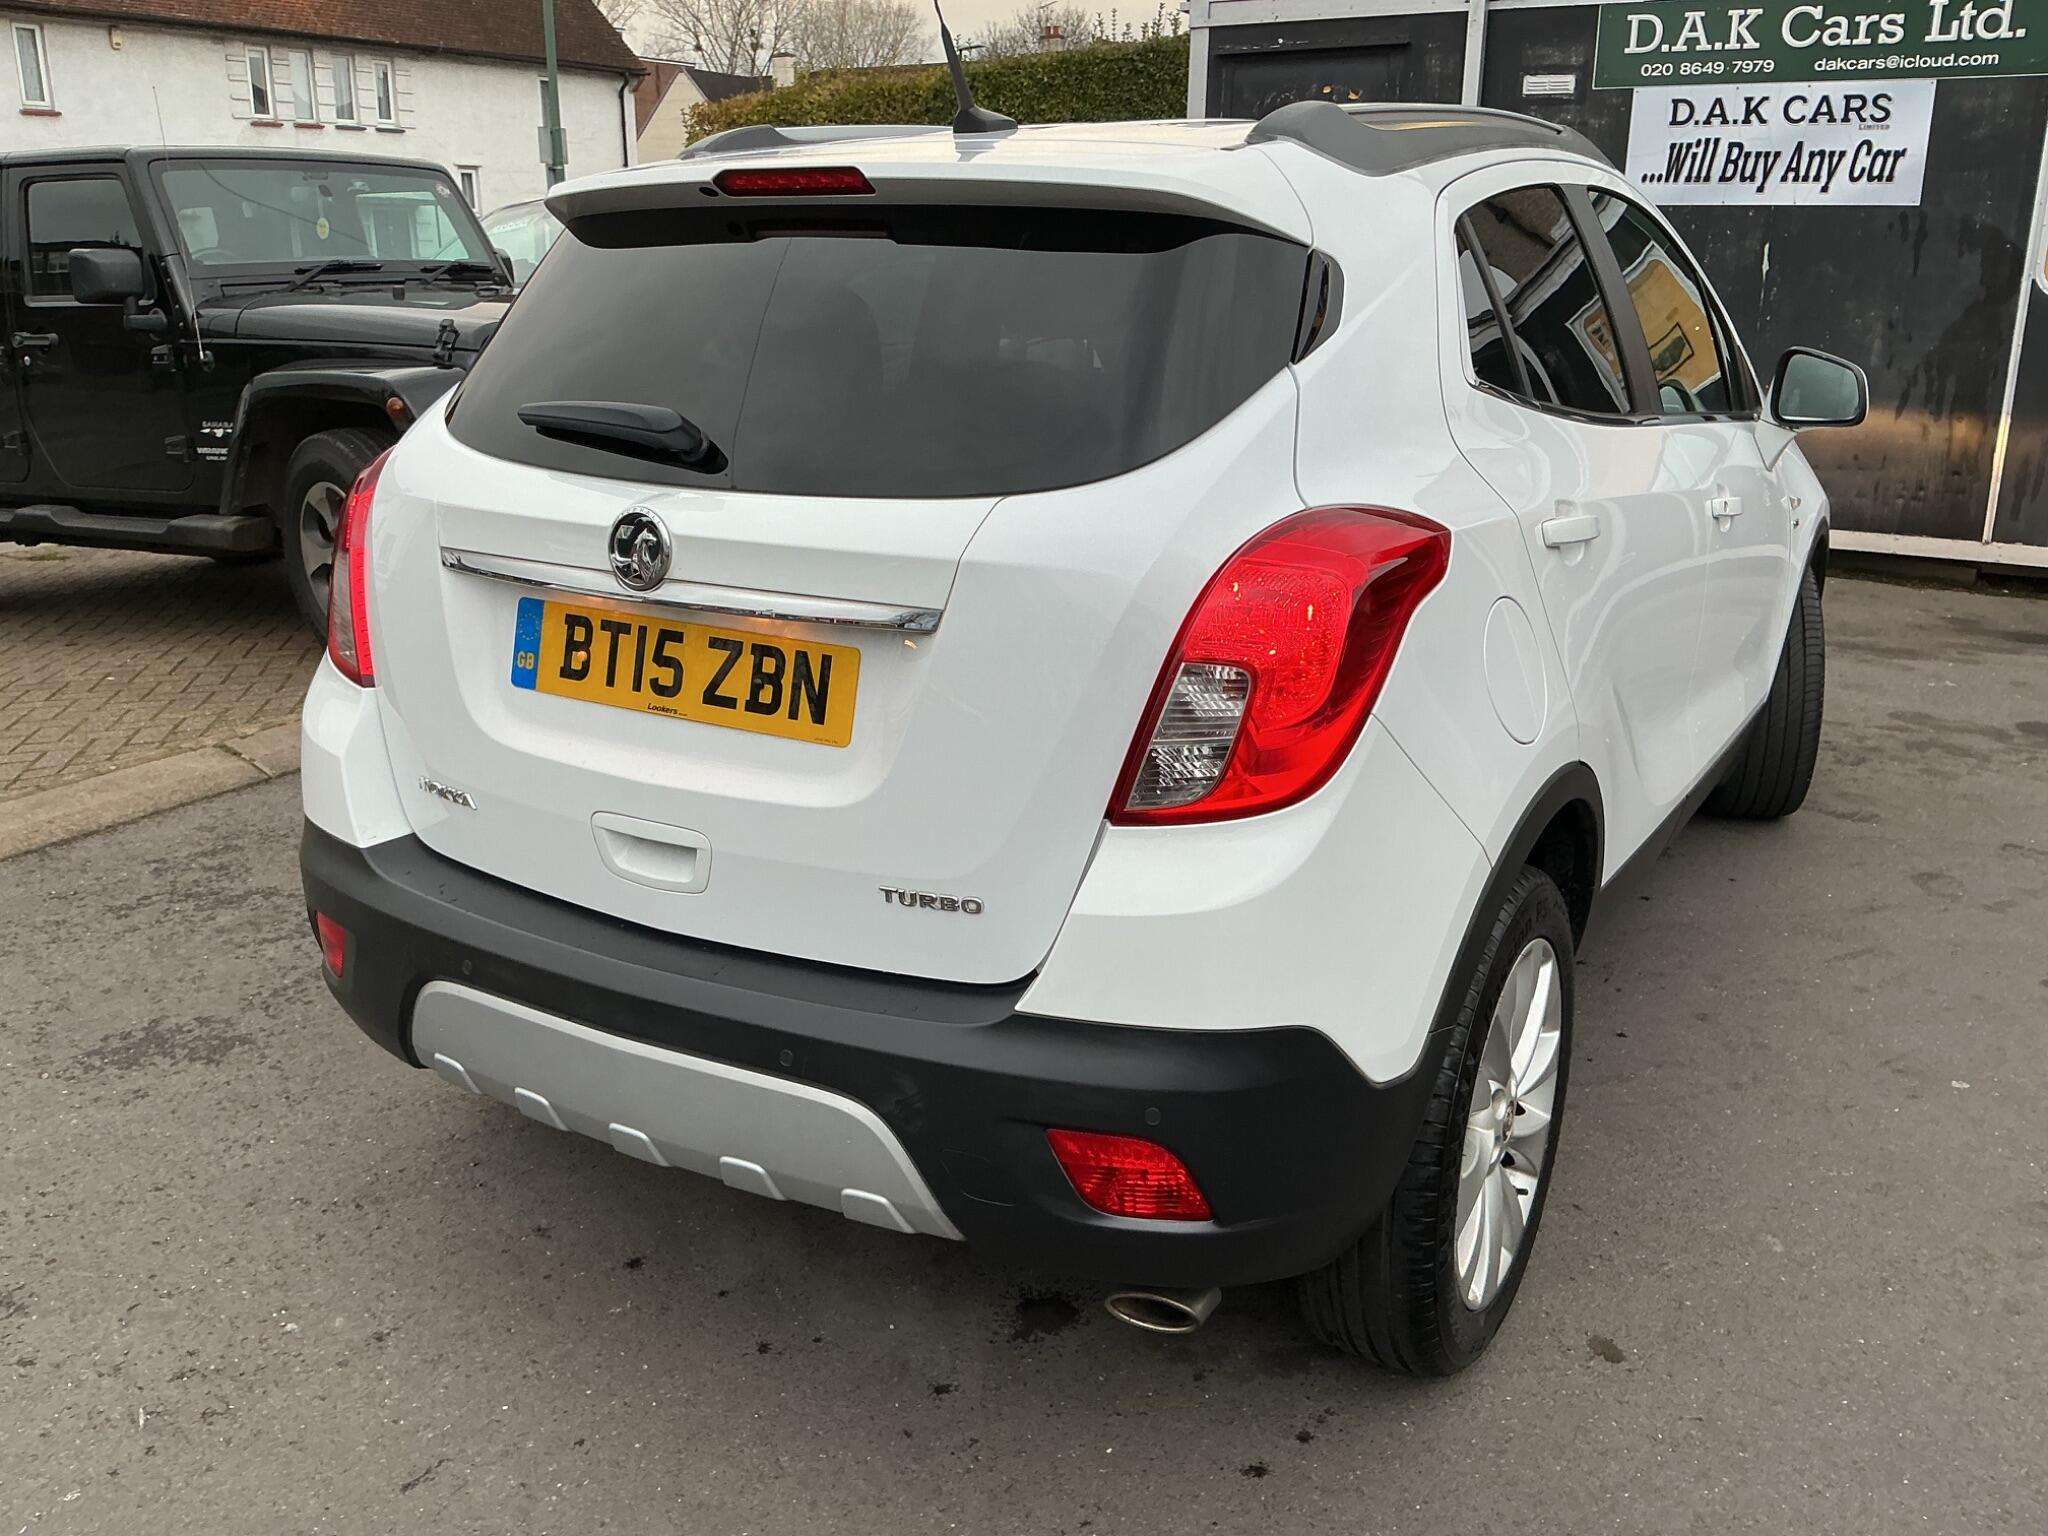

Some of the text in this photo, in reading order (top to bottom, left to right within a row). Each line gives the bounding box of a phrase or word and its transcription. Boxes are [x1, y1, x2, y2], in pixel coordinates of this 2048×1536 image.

[1624, 0, 2027, 54] D.A.K Cars Ltd.
[1641, 59, 1775, 76] 020 8649 7979
[1814, 53, 2000, 72] dakcars@icloud.com
[1668, 93, 1892, 126] D.A.K CARS
[1718, 141, 1781, 193] Buy
[1780, 140, 1846, 193] Any
[1848, 139, 1907, 184] Car
[516, 651, 535, 670] GB
[558, 612, 834, 726] BT15 ZBN
[647, 702, 678, 715] Lookers
[879, 885, 985, 914] TURBO
